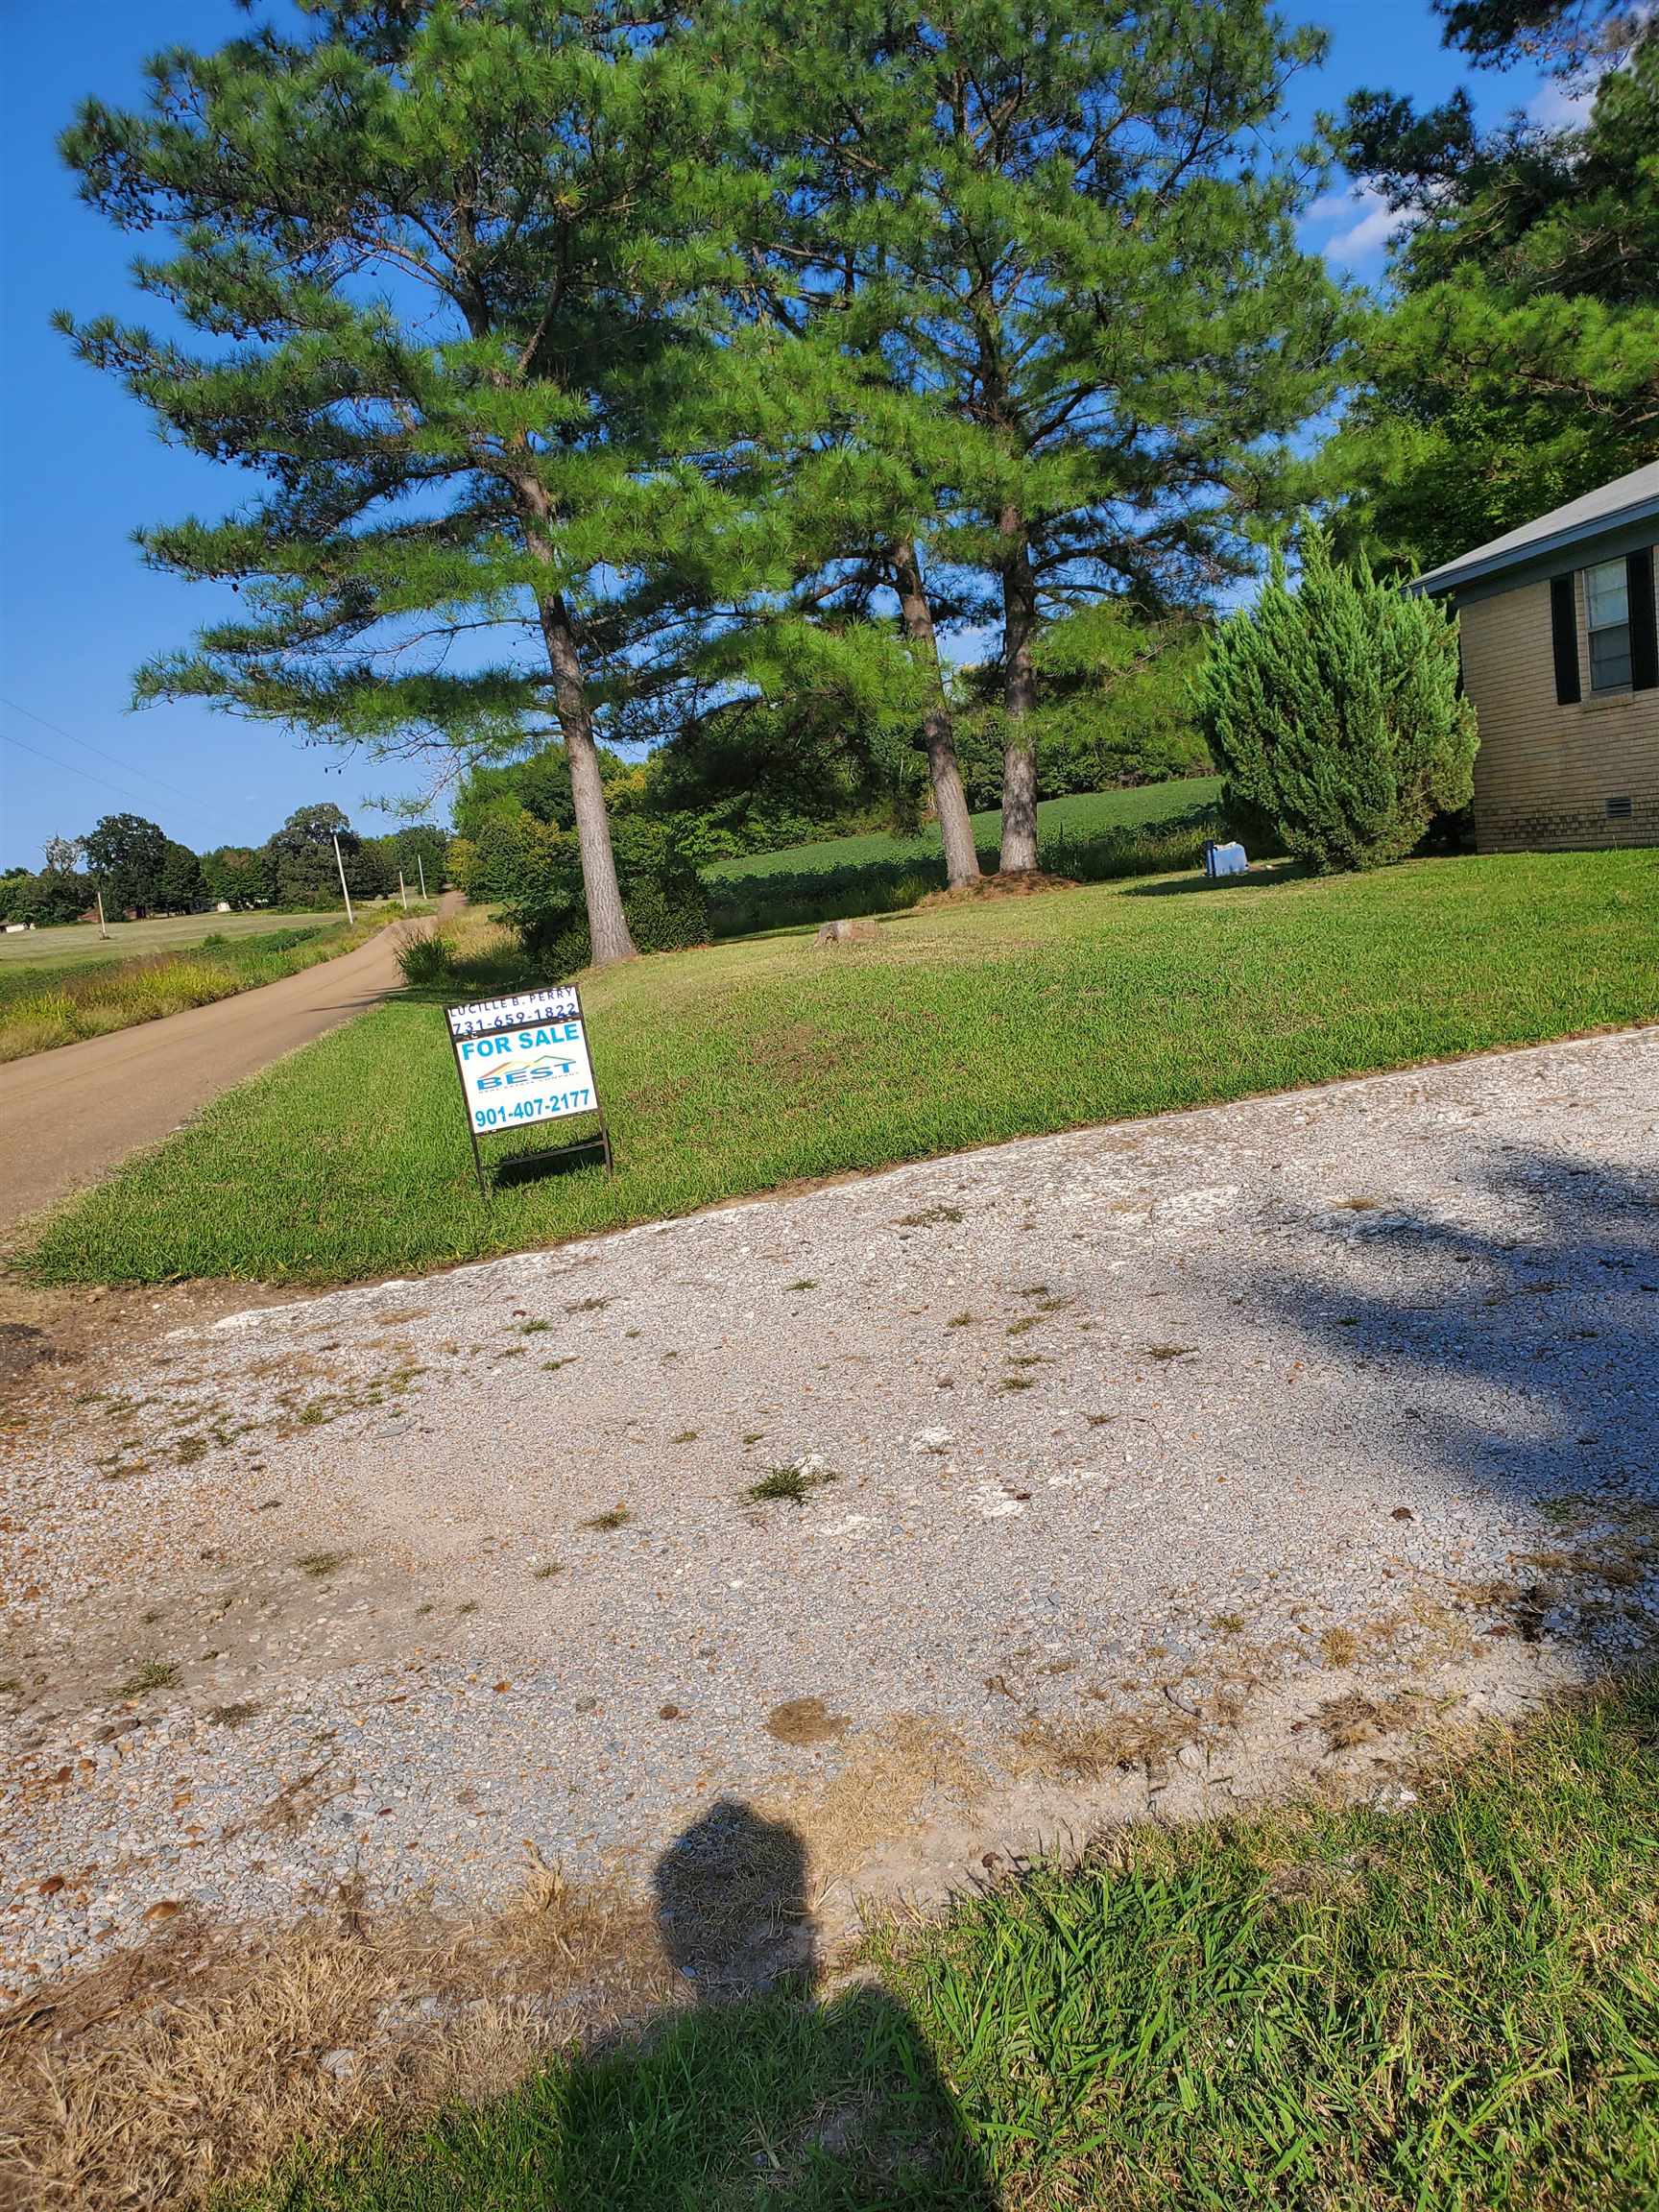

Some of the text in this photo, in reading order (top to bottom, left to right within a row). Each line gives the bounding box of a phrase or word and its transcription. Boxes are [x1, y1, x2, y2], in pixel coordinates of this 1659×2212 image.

[450, 999, 507, 1018] LUCILLE
[530, 988, 572, 1003] PERRY
[453, 1002, 577, 1036] 731-659-1822
[462, 1022, 580, 1061] FOR SALE
[476, 1061, 577, 1091] BEST
[475, 1089, 589, 1127] 901-407-2177
